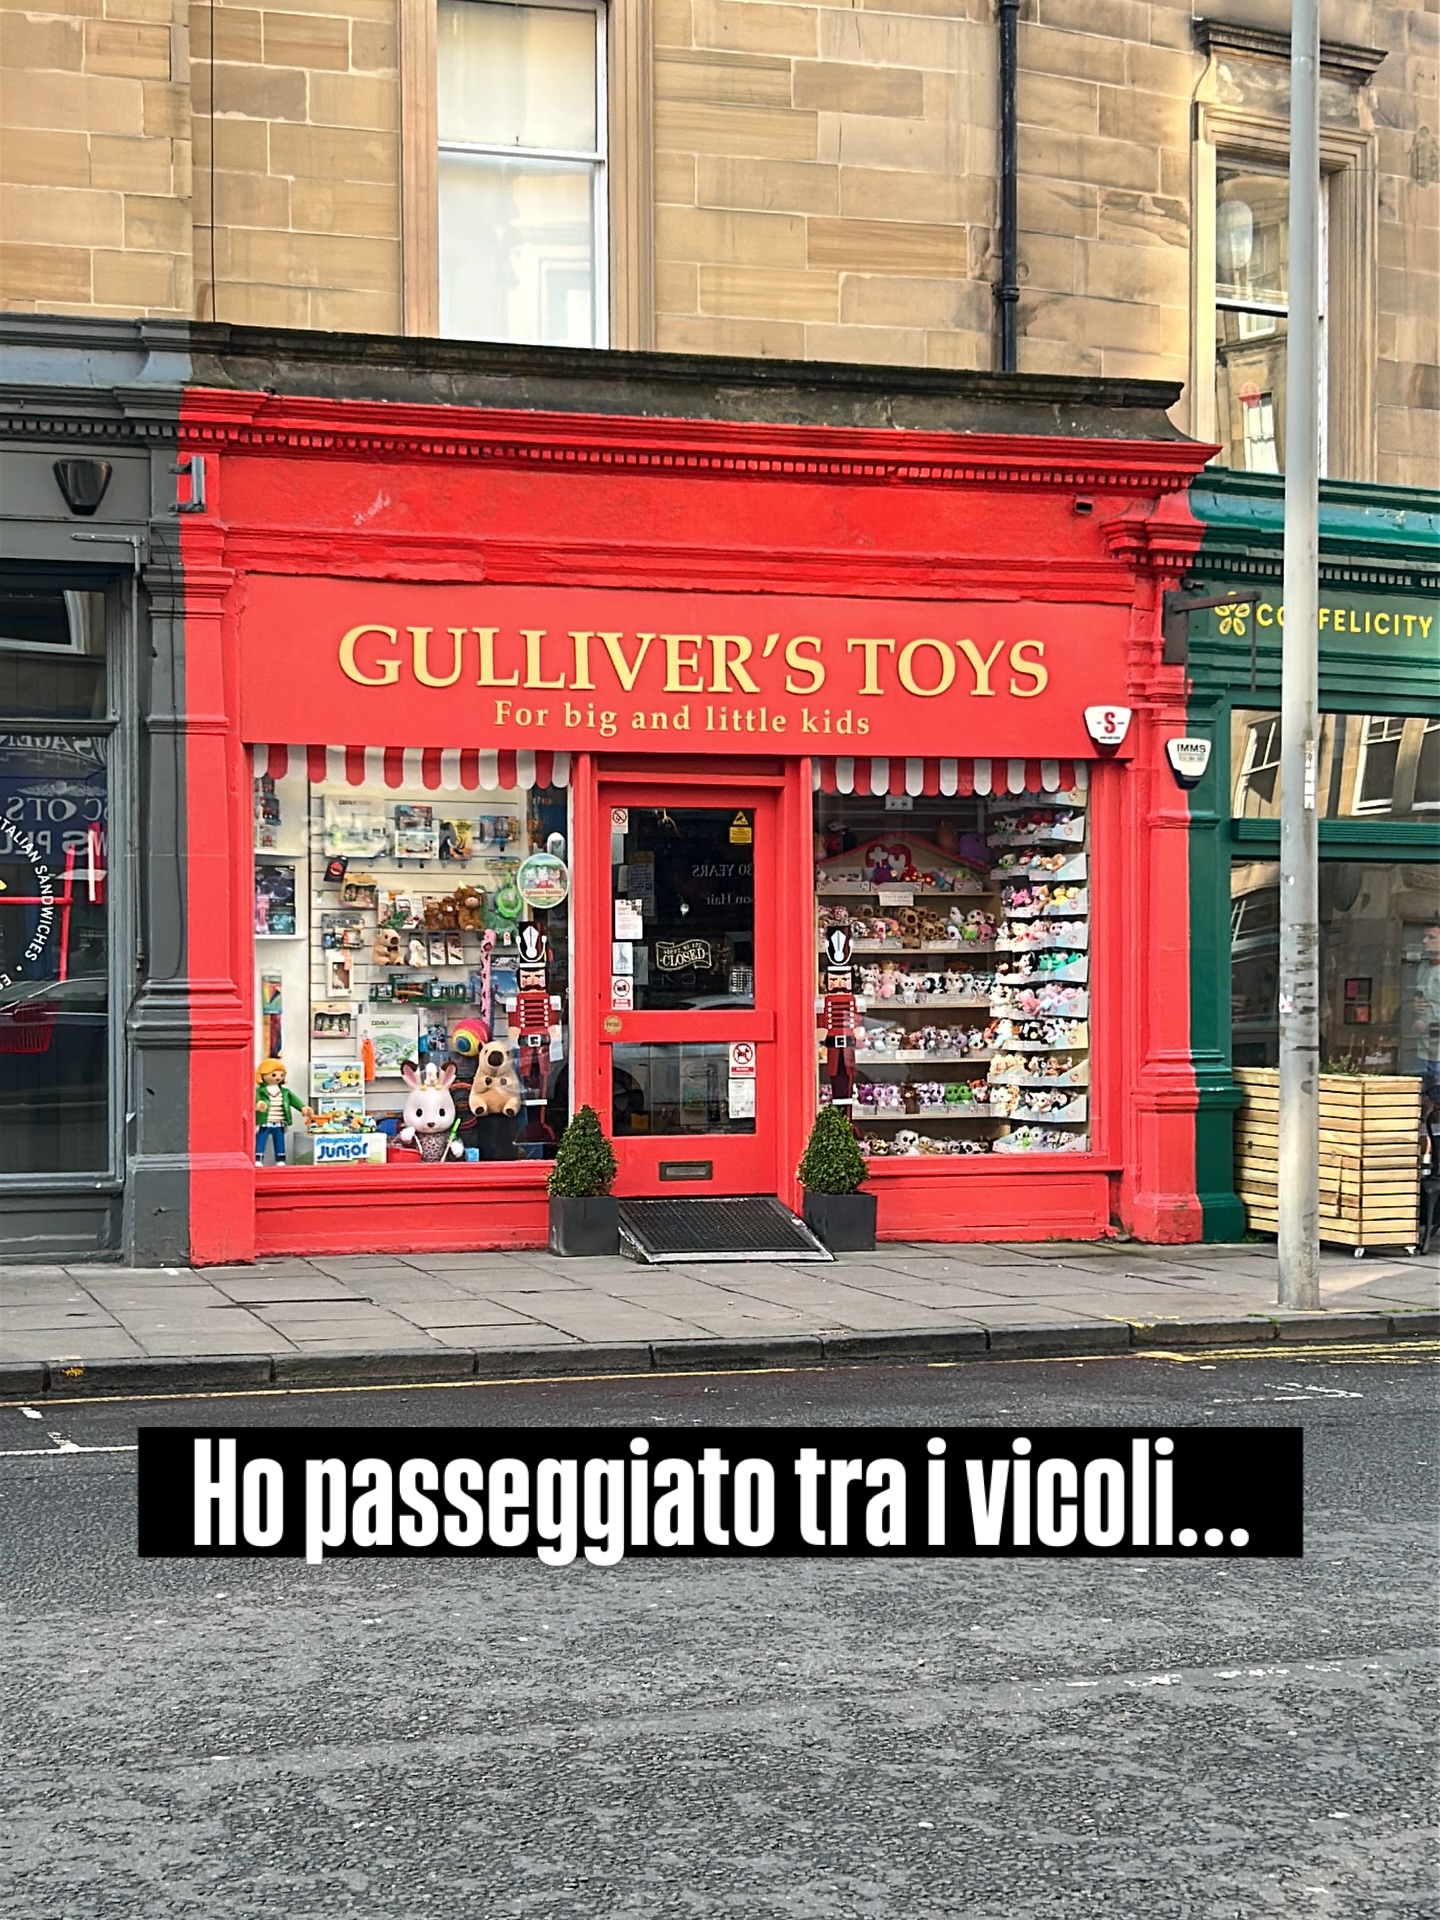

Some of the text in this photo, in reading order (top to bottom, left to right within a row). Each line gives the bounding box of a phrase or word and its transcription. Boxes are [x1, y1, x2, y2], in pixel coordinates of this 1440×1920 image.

[1256, 603, 1433, 639] CFELICITY
[338, 624, 1049, 698] GULLIVER'S TOYS
[494, 700, 870, 737] For big and little kids
[1104, 712, 1116, 733] S
[1177, 744, 1206, 753] IMMS
[0, 816, 42, 864] TALIAN
[25, 864, 55, 962] SANDWICHES
[662, 948, 706, 966] CLOSED
[316, 1135, 362, 1146] playmobil
